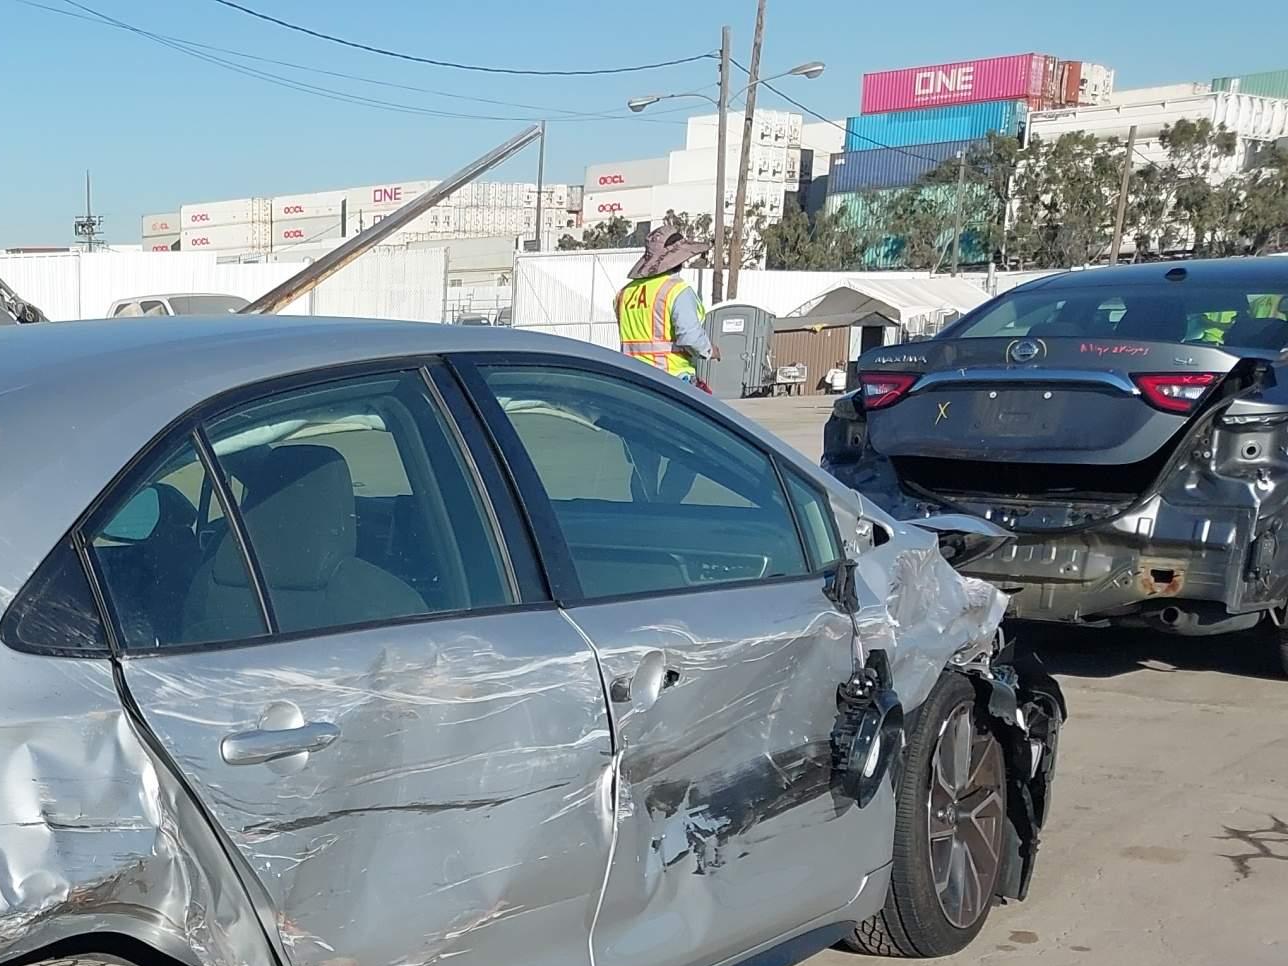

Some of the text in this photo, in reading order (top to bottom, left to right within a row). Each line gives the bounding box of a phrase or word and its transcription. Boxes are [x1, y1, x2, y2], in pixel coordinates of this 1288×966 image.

[914, 67, 974, 96] ONE
[598, 175, 624, 185] OOCL
[374, 187, 402, 202] ONE
[284, 206, 304, 214] OOCL
[598, 203, 623, 212] OOCL
[191, 213, 210, 222] OOCL
[284, 230, 304, 238] OOCL
[191, 237, 210, 245] OOCL
